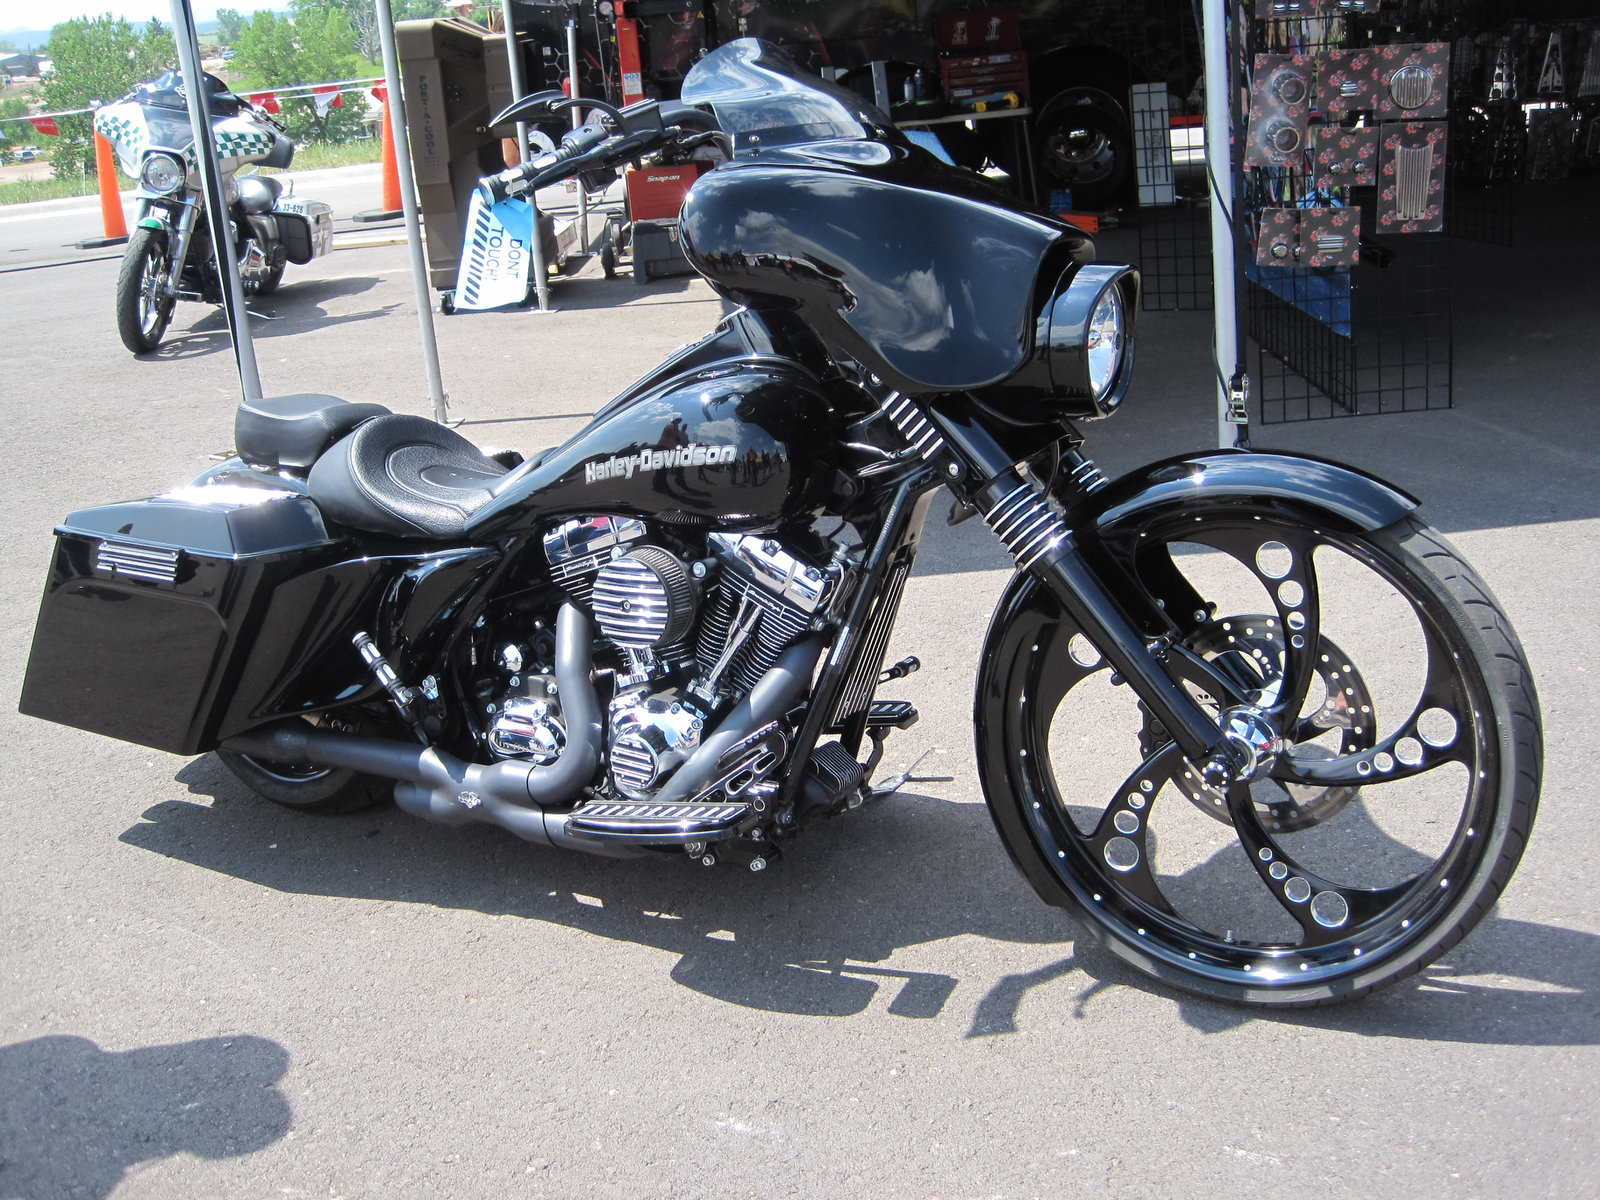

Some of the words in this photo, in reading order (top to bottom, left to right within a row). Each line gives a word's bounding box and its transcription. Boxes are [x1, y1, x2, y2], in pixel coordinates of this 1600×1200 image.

[647, 174, 681, 183] Snap-on
[507, 238, 523, 280] DONT
[584, 442, 738, 485] Harley-Davidson
